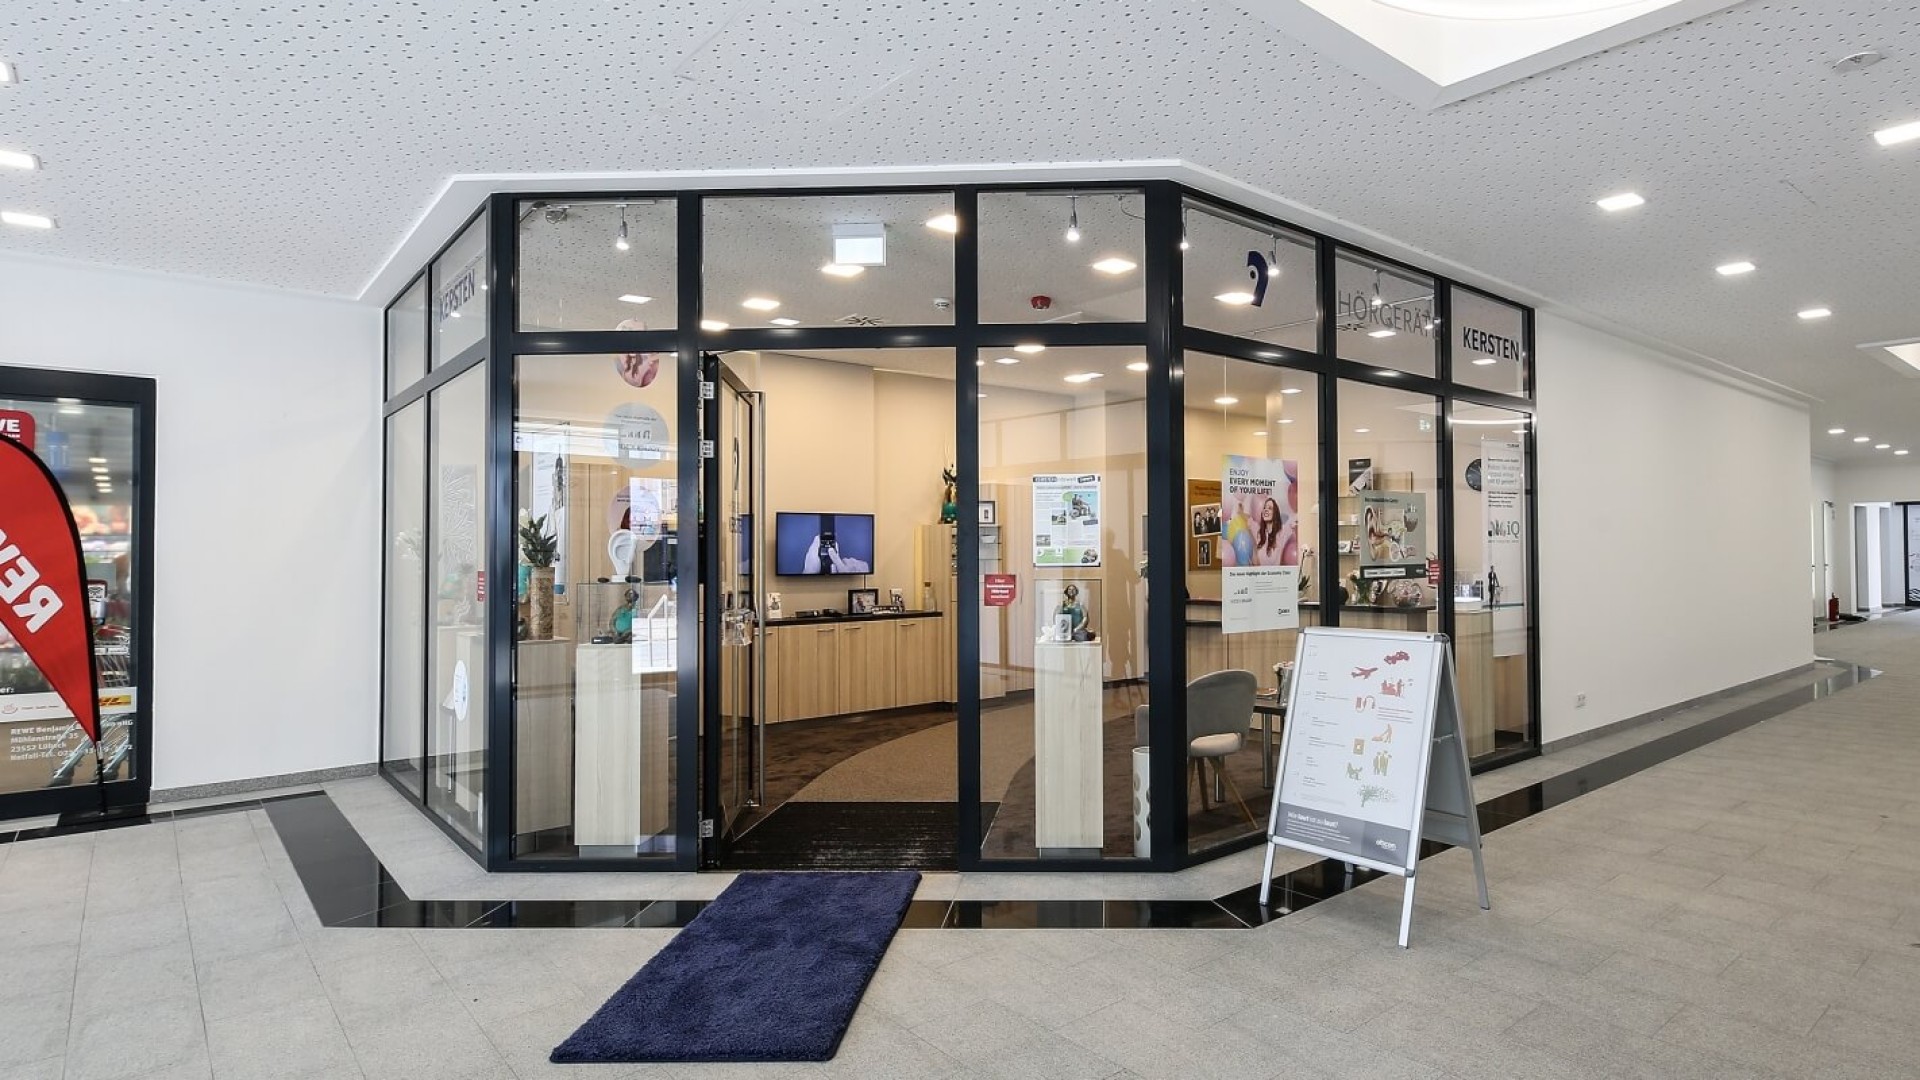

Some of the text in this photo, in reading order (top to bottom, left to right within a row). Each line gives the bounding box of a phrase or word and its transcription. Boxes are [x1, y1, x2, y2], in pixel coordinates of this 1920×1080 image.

[440, 268, 475, 322] KERSTEN
[1463, 326, 1520, 361] KERSTEN
[1229, 467, 1249, 476] ENJOY
[1229, 477, 1276, 487] EVERY MOMENT
[1229, 485, 1238, 494] OF
[1239, 486, 1256, 495] YOUR
